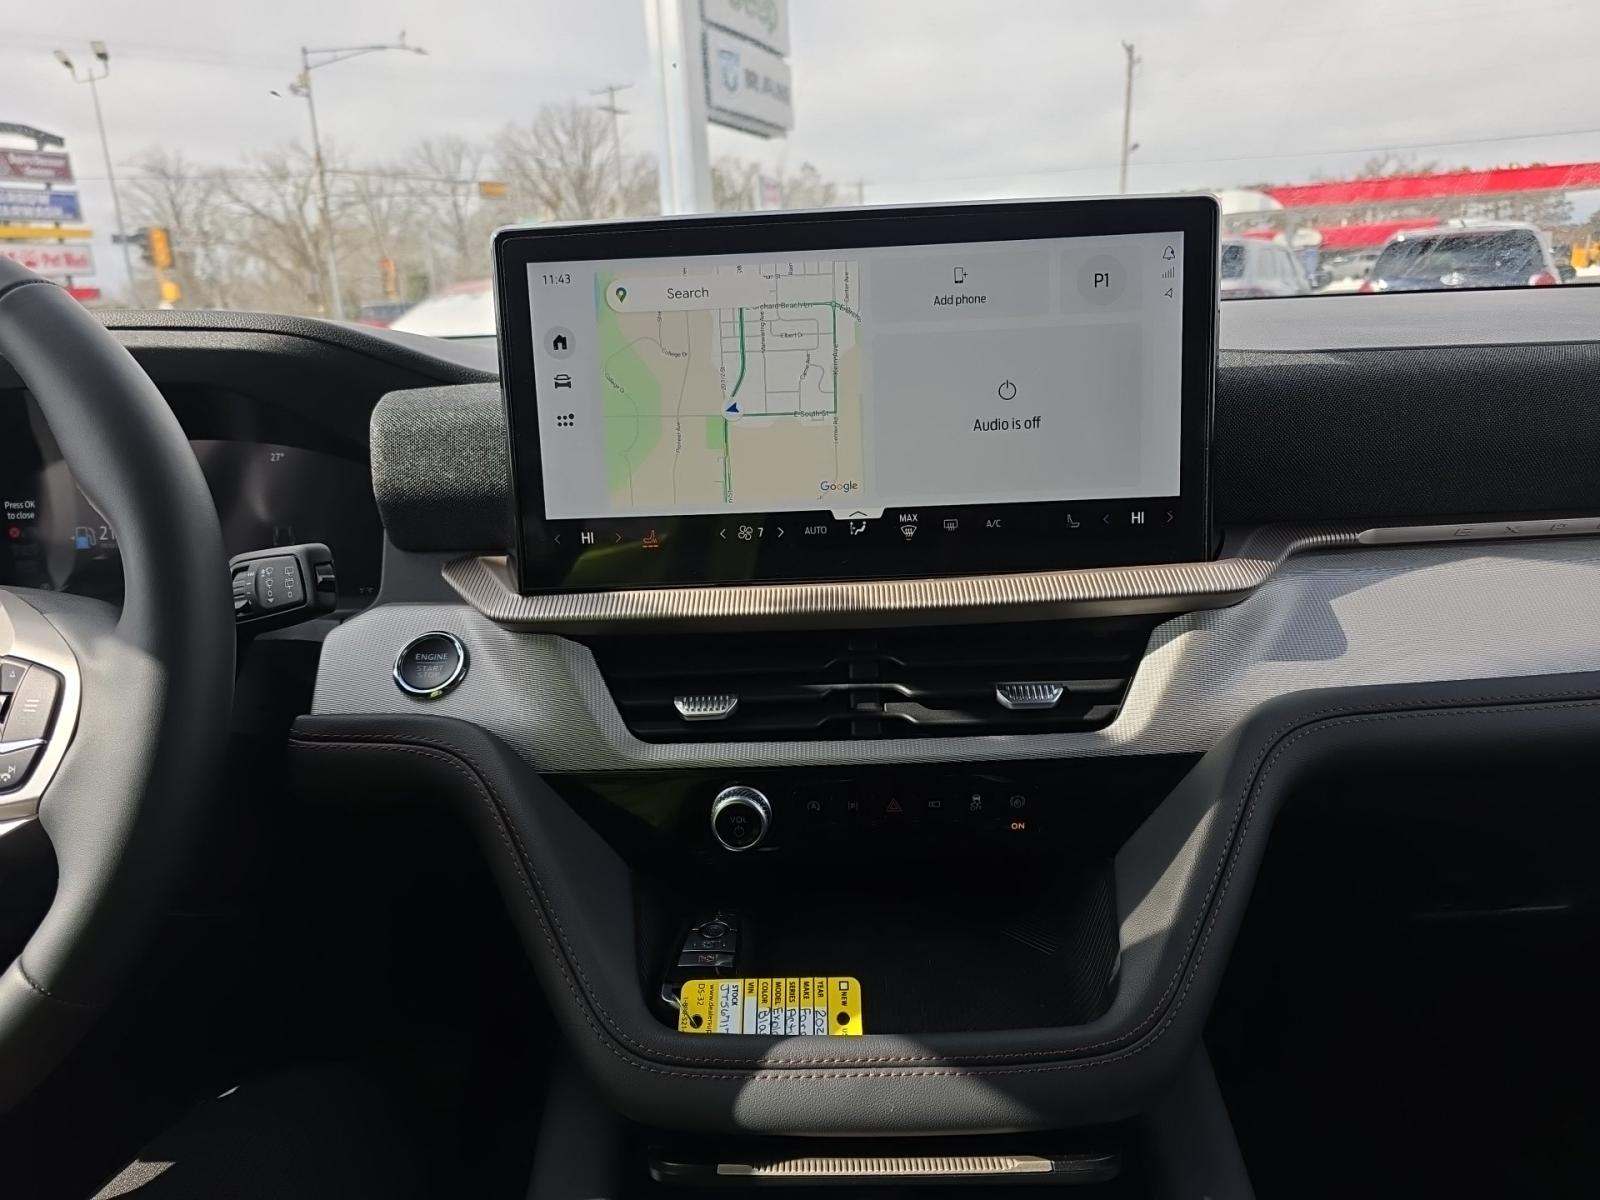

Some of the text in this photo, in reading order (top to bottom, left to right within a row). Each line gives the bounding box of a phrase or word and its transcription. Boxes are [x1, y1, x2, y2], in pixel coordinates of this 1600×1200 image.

[542, 273, 571, 286] 11:43
[1093, 272, 1110, 288] P1
[667, 287, 709, 300] Search
[933, 293, 987, 306] Add phone
[800, 410, 819, 418] South
[973, 415, 1042, 432] Audio is off
[820, 480, 859, 493] Google
[4, 500, 36, 511] Press OK
[7, 511, 35, 520] to close
[899, 513, 918, 523] MAX
[1131, 511, 1145, 525] HI
[804, 524, 828, 536] AUTO
[985, 518, 1003, 529] A/C
[581, 531, 595, 545] HI
[757, 526, 764, 538] 7
[415, 653, 448, 661] ENGINE
[729, 816, 748, 824] VOL
[1011, 822, 1025, 830] ON
[747, 981, 755, 994] VIN
[761, 981, 769, 1004] COLOR
[774, 981, 782, 1005] MODEL
[816, 981, 824, 998] YEAR
[697, 983, 706, 1006] DS-32
[731, 984, 739, 1006] STOCK
